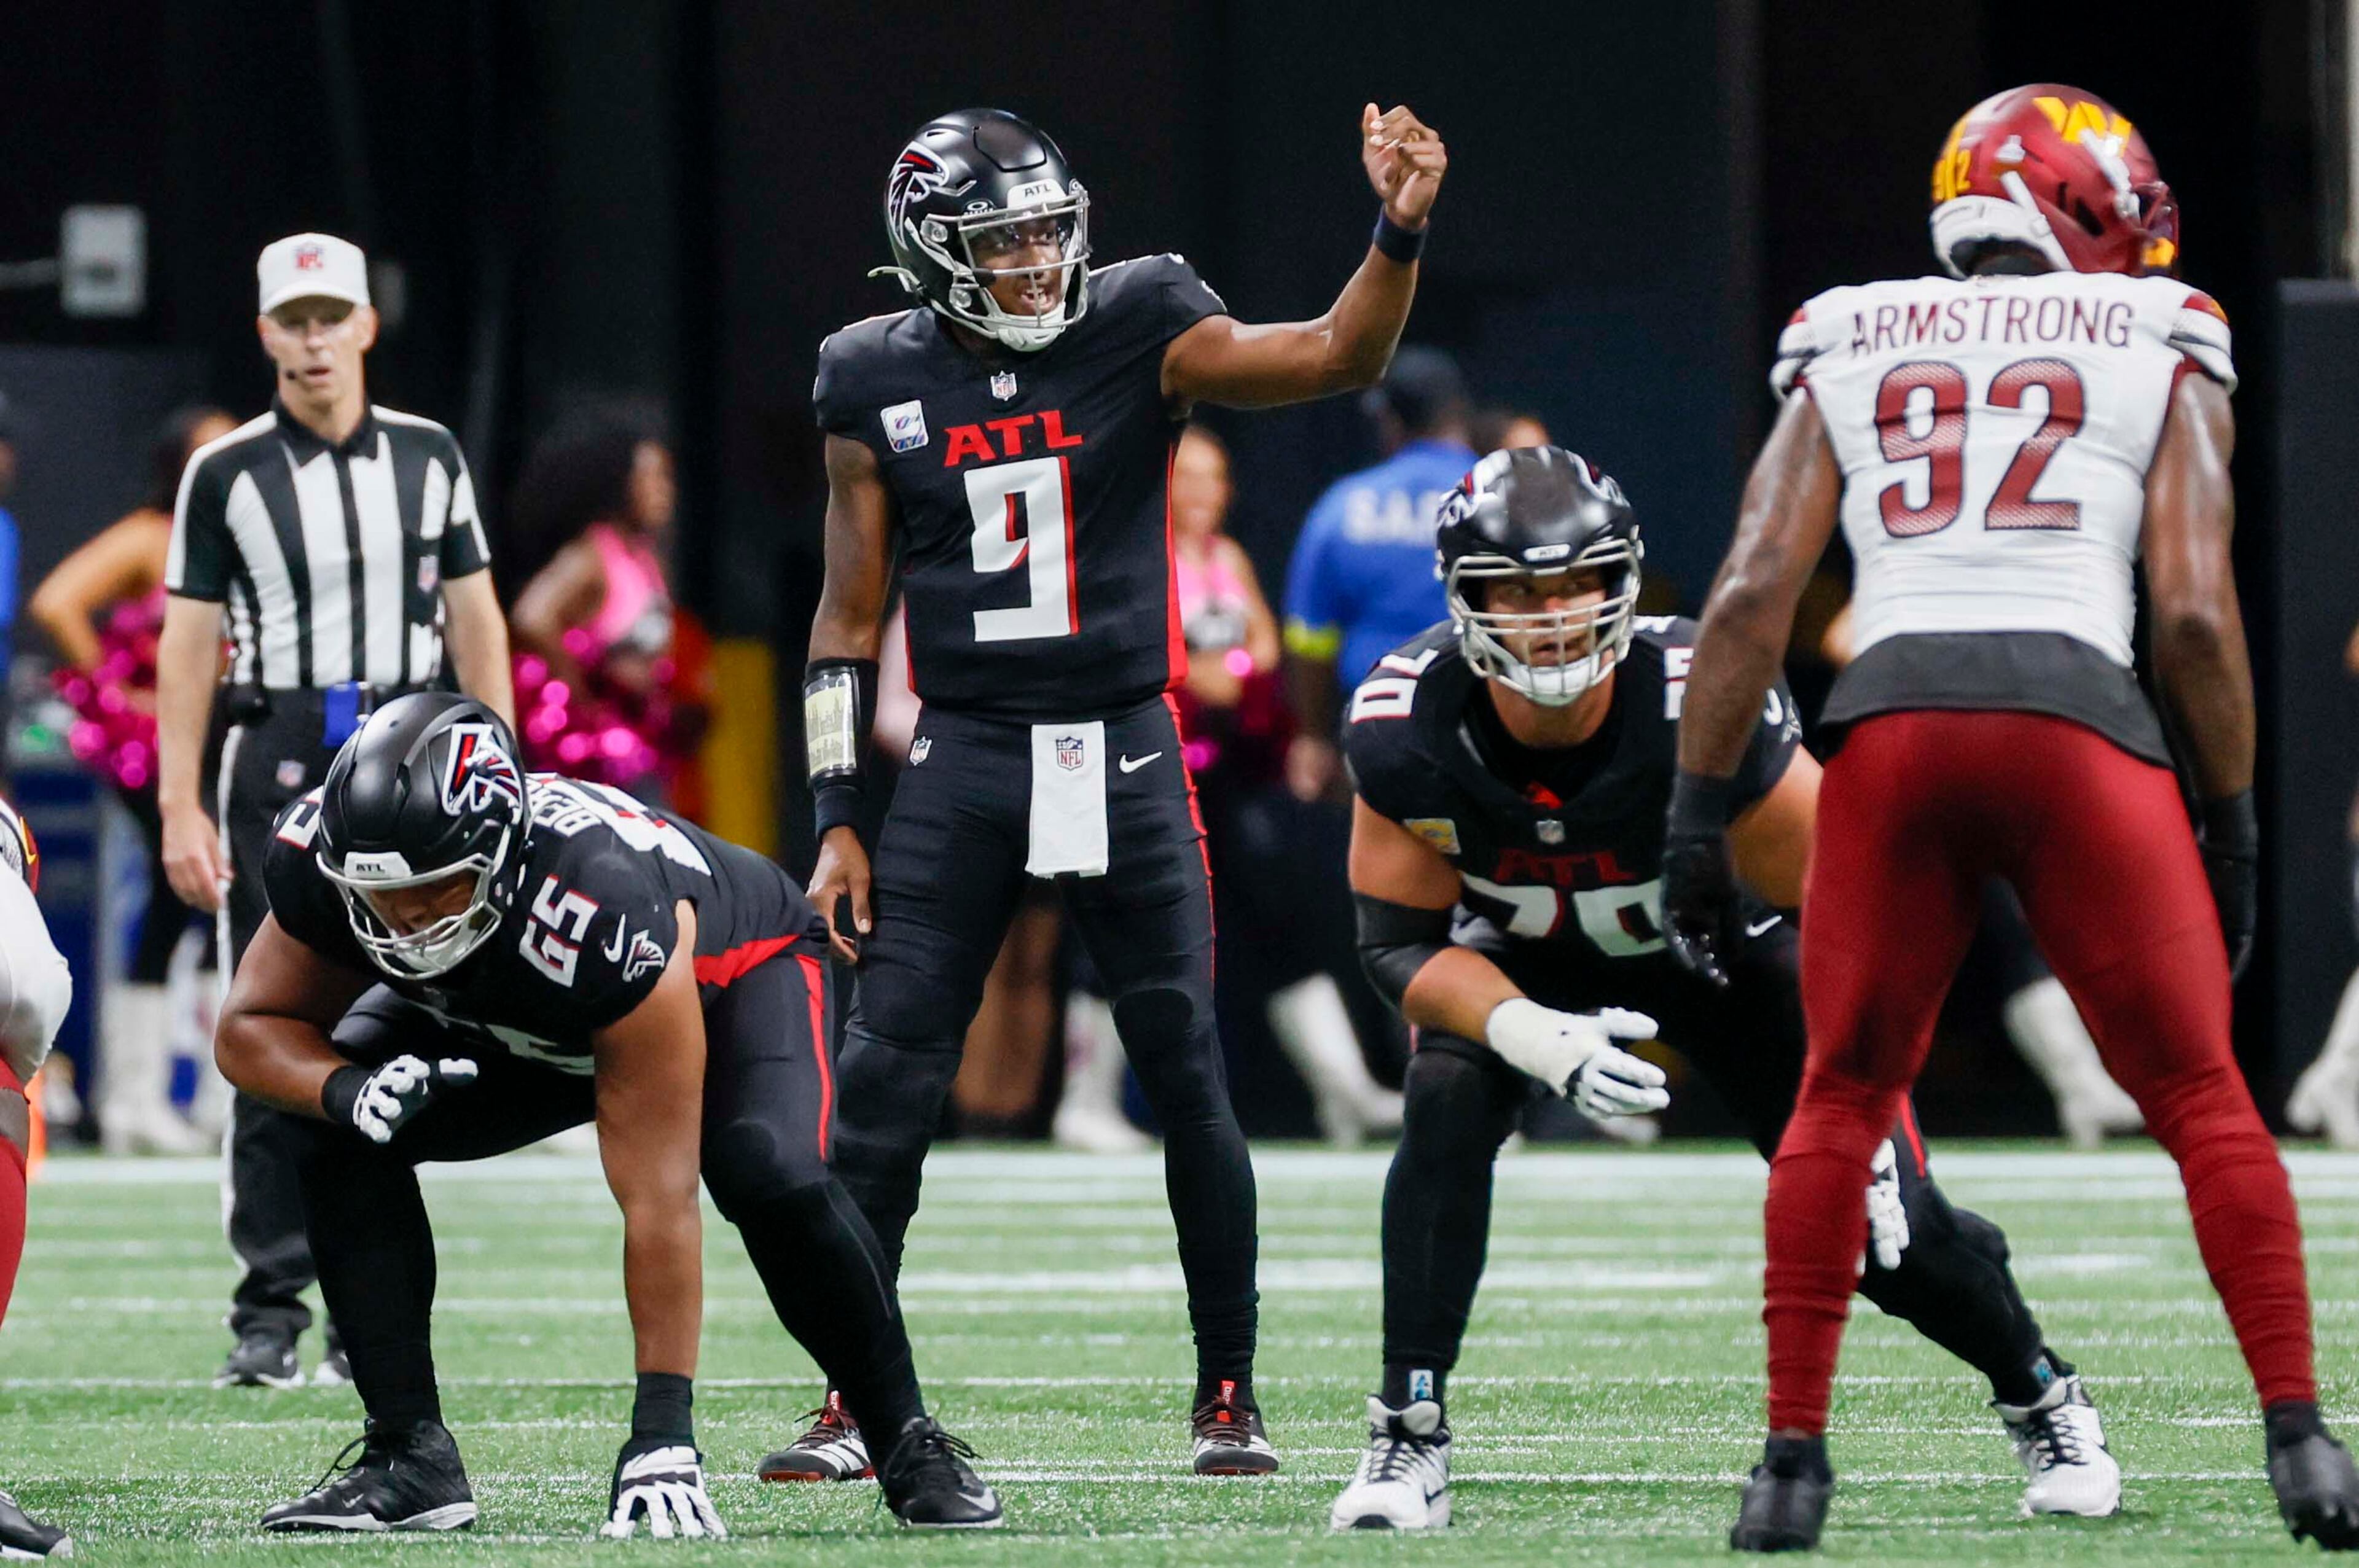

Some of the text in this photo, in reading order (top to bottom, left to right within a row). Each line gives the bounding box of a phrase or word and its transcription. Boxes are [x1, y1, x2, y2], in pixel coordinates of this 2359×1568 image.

[1024, 184, 1052, 197] ATL
[1851, 297, 2134, 359] ARMSTRONG
[943, 410, 1083, 468] ATL
[1871, 357, 2085, 539] 92
[963, 456, 1080, 642] 9
[1060, 751, 1081, 766] NFL
[356, 863, 385, 873] ATL
[1493, 848, 1638, 886] ATL
[518, 873, 600, 988] 65
